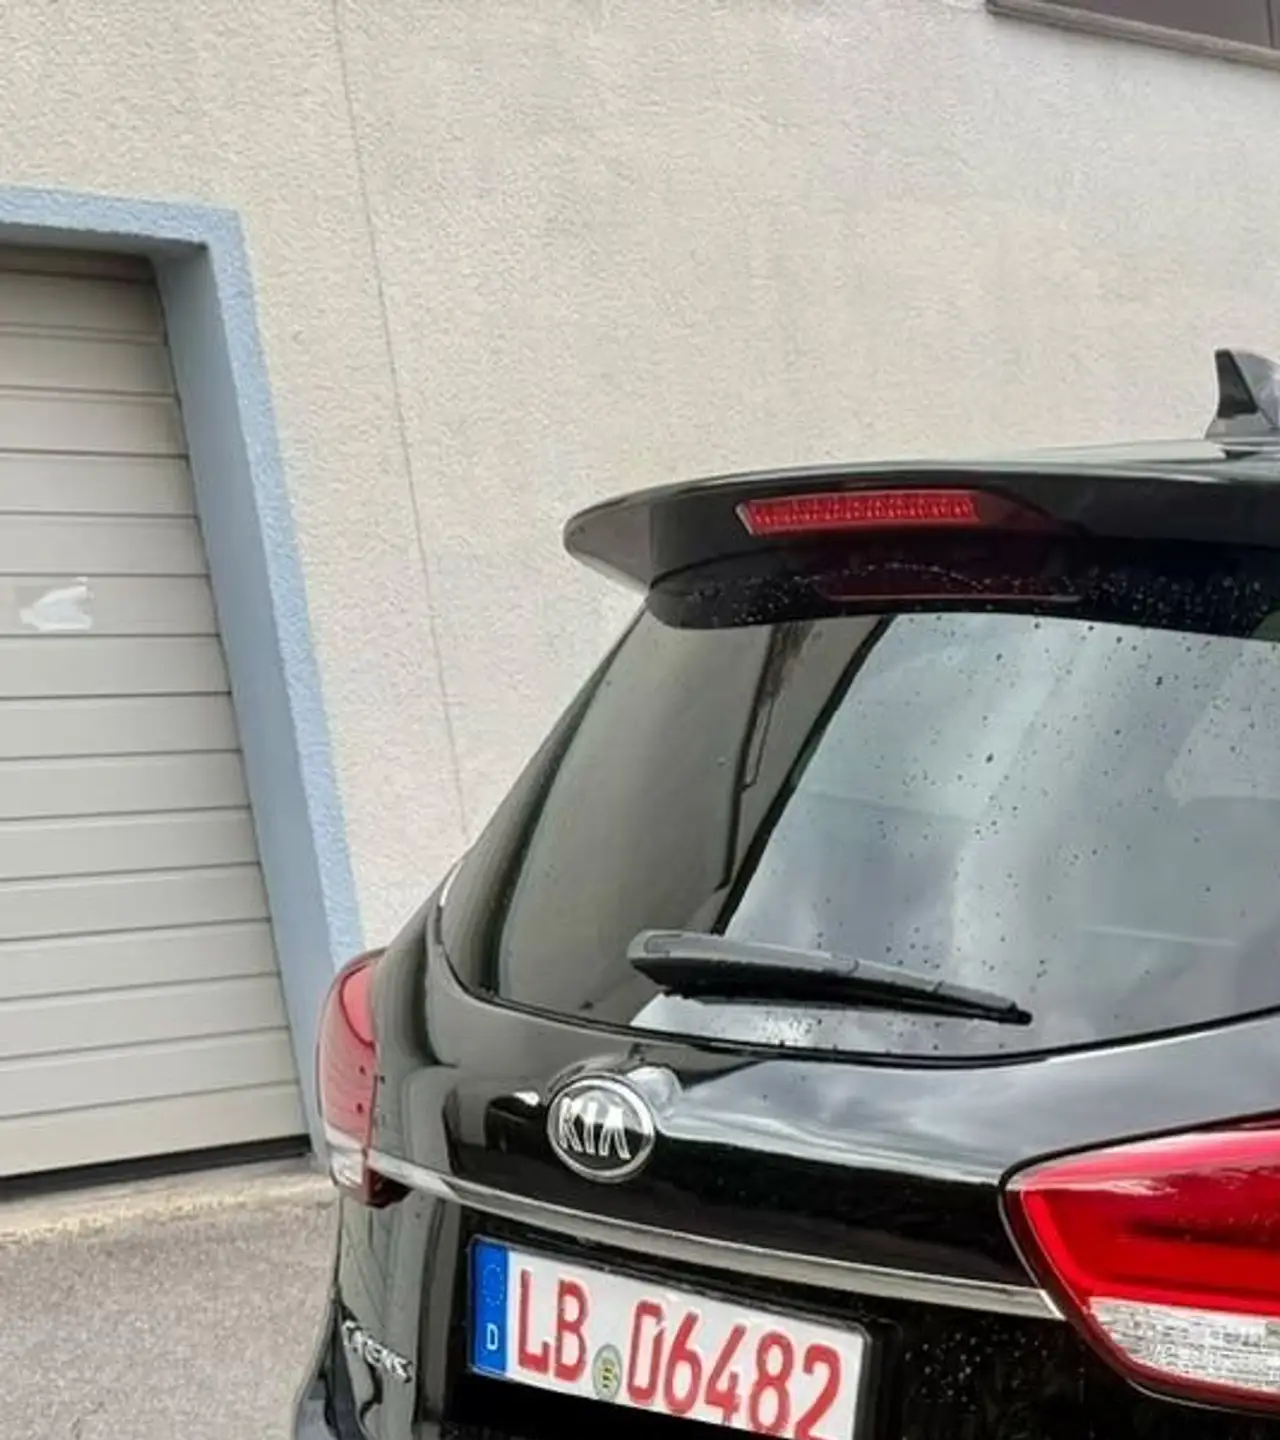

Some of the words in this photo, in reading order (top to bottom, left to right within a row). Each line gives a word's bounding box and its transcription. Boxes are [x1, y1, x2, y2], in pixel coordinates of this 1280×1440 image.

[560, 1096, 631, 1160] KIA
[486, 1322, 500, 1352] D
[516, 1267, 590, 1383] LB
